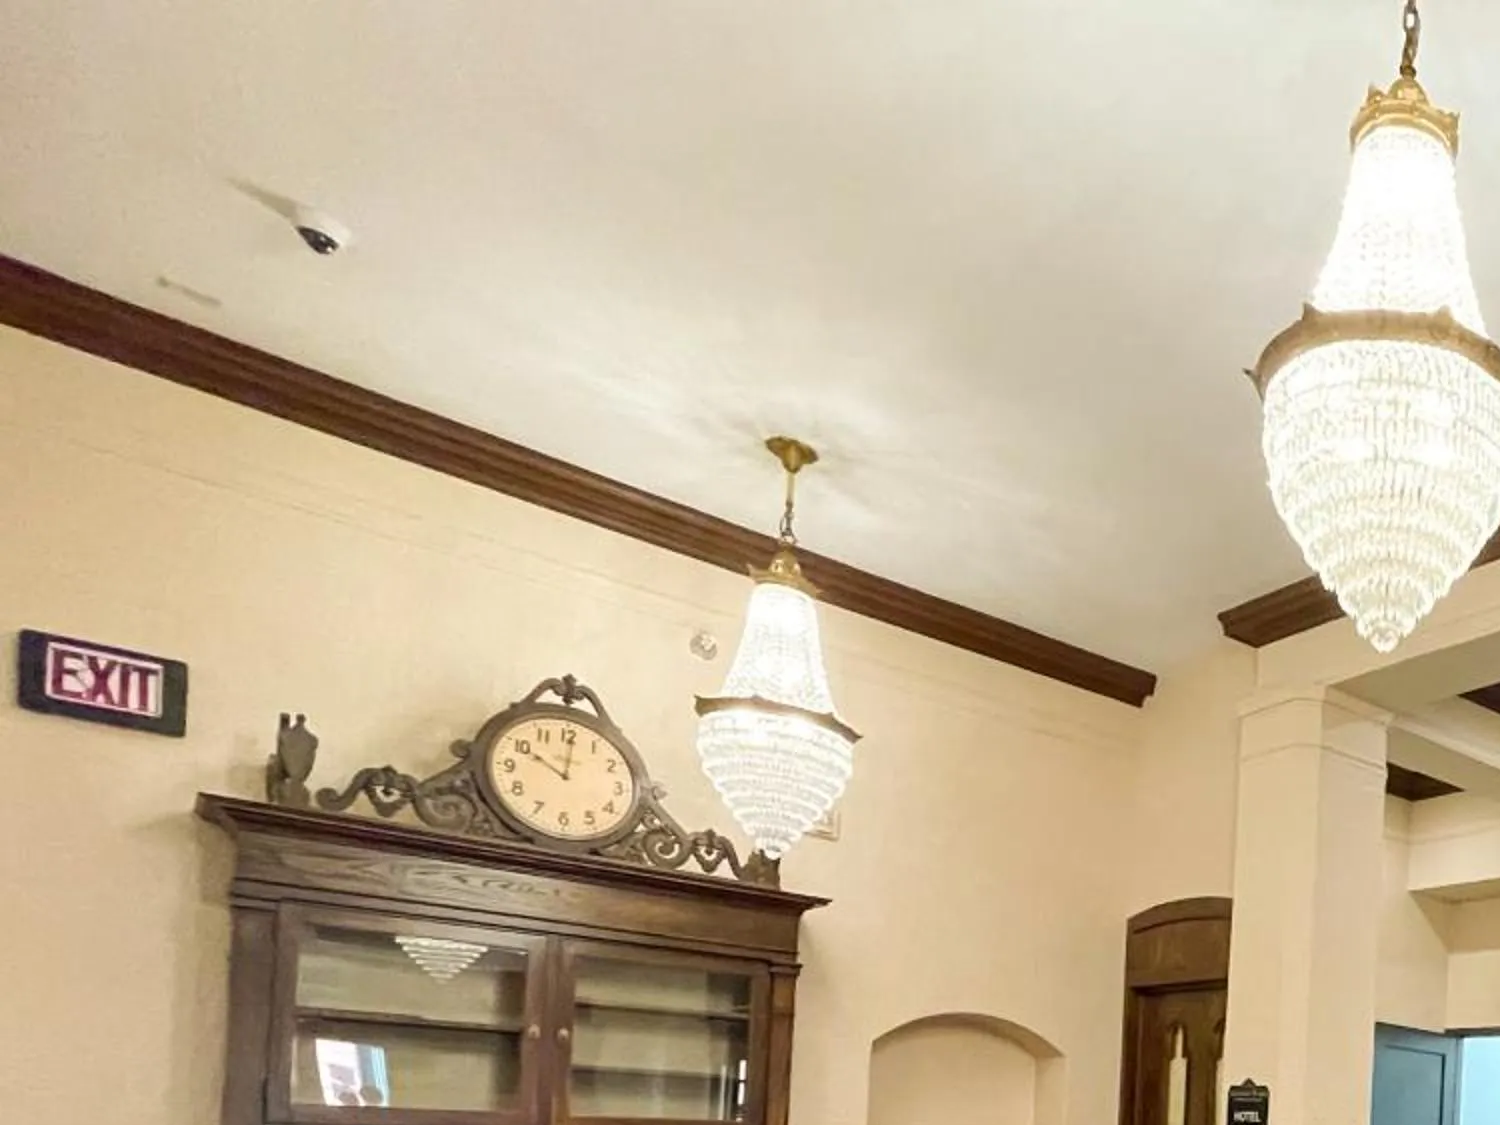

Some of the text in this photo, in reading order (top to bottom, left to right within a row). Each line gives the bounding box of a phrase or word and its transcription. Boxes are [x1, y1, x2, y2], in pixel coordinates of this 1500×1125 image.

[52, 649, 160, 713] EXIT
[537, 727, 551, 744] 11
[560, 727, 577, 746] 12
[514, 739, 531, 755] 10
[591, 740, 597, 754] 1
[503, 758, 516, 774] 9
[607, 758, 617, 774] 2
[511, 780, 525, 797] 8
[613, 781, 624, 796] 3
[533, 800, 545, 815] 7
[602, 800, 614, 814] 4
[557, 811, 570, 827] 6
[583, 810, 596, 825] 5
